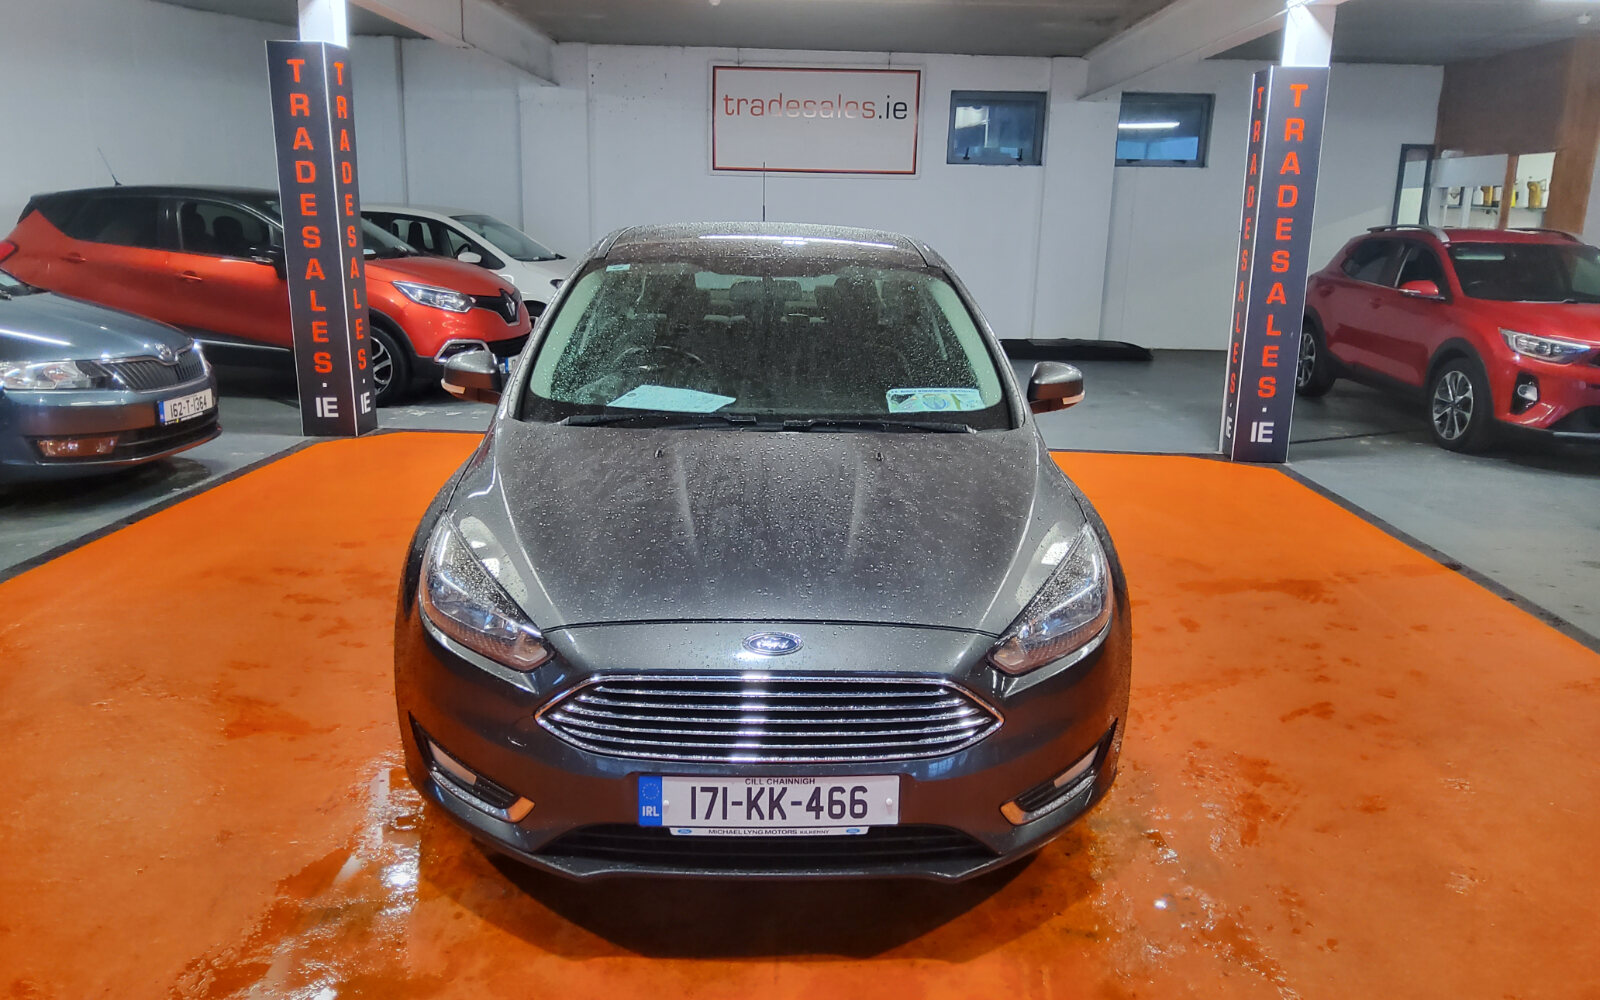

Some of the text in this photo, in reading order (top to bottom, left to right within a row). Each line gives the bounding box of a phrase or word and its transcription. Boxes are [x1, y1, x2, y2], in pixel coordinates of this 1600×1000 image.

[723, 92, 908, 120] tradesales.ie
[170, 394, 208, 419] 162-T-1364
[642, 805, 660, 817] IRL
[690, 785, 868, 821] 171-KK-466
